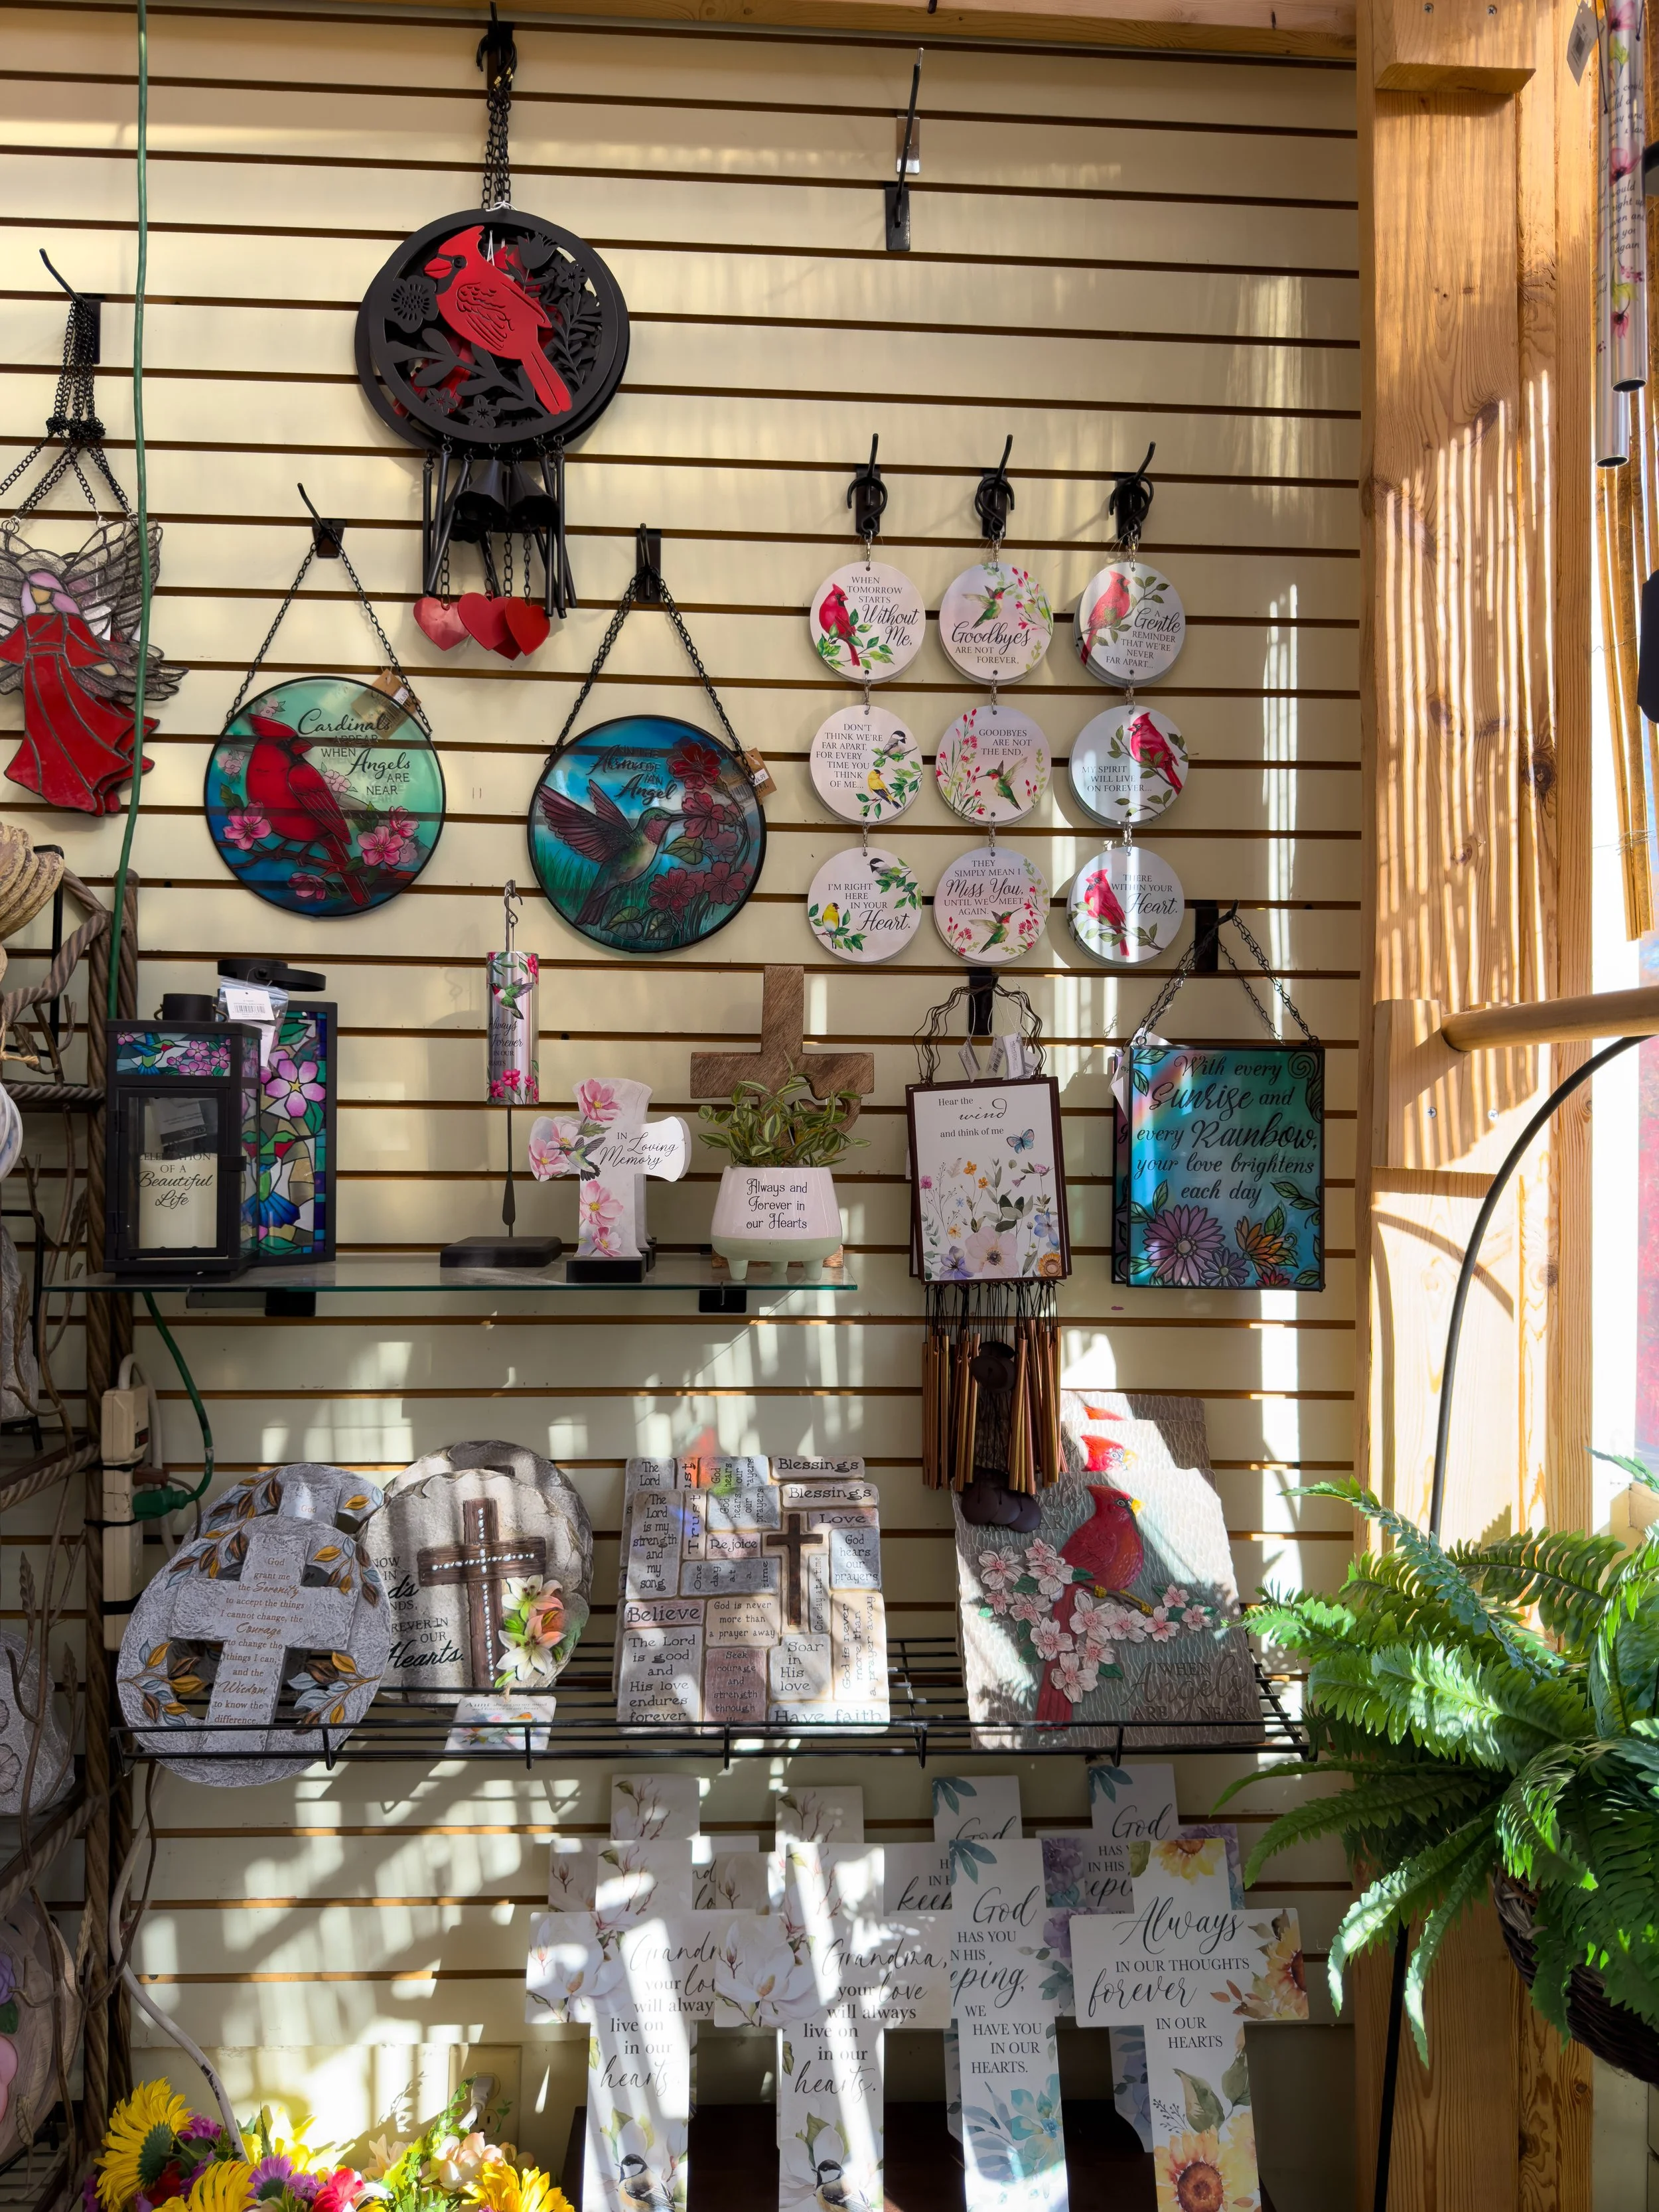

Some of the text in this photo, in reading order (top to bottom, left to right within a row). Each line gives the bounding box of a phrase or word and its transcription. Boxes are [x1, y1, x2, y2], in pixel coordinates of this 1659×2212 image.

[862, 604, 920, 625] Without
[885, 625, 912, 646] Me,
[952, 621, 1031, 655] Goodbyes
[297, 708, 390, 735] Cardinals
[839, 743, 867, 751] APART,
[321, 747, 410, 780] WHEN Angels
[387, 773, 410, 782] ARE
[366, 786, 398, 795] NEAR
[614, 773, 677, 806] Angel
[946, 879, 984, 898] Miss
[856, 909, 910, 931] Heart.
[1173, 1055, 1282, 1086] With every
[956, 1098, 1007, 1120] wind
[1149, 1082, 1295, 1122] Sunrise and
[958, 1128, 979, 1137] think
[1137, 1112, 1317, 1151] every Rainbow,
[627, 1132, 679, 1157] Loving
[600, 1145, 662, 1170] Memory
[1133, 1151, 1314, 1183] your love brightens
[138, 1171, 213, 1191] Beautiful
[747, 1178, 807, 1197] Always and
[155, 1189, 189, 1209] Life
[1181, 1179, 1263, 1209] each day
[749, 1196, 805, 1212] Forever in
[747, 1213, 807, 1229] our Hearts
[778, 1458, 859, 1473] Blessings
[649, 1494, 666, 1505] The
[789, 1487, 871, 1501] Blessings
[646, 1506, 668, 1518] Lord
[820, 1514, 867, 1524] Love
[643, 1522, 669, 1535] is my
[687, 1495, 700, 1554] Trust
[632, 1534, 677, 1548] strength
[710, 1539, 757, 1552] Rejoice
[646, 1546, 663, 1559] and
[267, 1557, 285, 1566] God
[253, 1572, 276, 1580] grant
[647, 1564, 662, 1578] my
[253, 1582, 299, 1599] Serenity
[640, 1578, 666, 1591] song
[236, 1598, 262, 1607] accept
[280, 1600, 305, 1610] things
[257, 1613, 287, 1623] change,
[627, 1606, 700, 1623] Believe
[236, 1621, 281, 1640] Courage
[420, 1631, 447, 1643] OUR
[788, 1641, 824, 1652] Soar
[788, 1655, 802, 1664] in
[780, 1666, 804, 1678] His
[1157, 1662, 1212, 1676] WHEN
[780, 1681, 811, 1691] love
[1120, 1655, 1248, 1720] Angels
[1132, 1706, 1248, 1721] ARE NEAR
[973, 1885, 1040, 1927] God
[1112, 1895, 1244, 1955] Always
[958, 1931, 1017, 1943] HAS YOU
[822, 1938, 948, 1976] Grandma,
[964, 1949, 985, 1960] HIS
[1116, 1958, 1250, 1973] IN OUR THOUGHTS
[837, 1971, 928, 2003] your love
[1088, 1967, 1198, 2018] forever
[827, 2004, 916, 2024] will always
[965, 2005, 986, 2017] WE
[804, 2023, 859, 2037] live on
[973, 2022, 1042, 2035] HAVE YOU
[1156, 2017, 1206, 2030] IN OUR
[991, 2041, 1041, 2054] IN OUR
[1168, 2035, 1223, 2049] HEARTS
[818, 2046, 833, 2061] in
[971, 2061, 1028, 2074] HEARTS.
